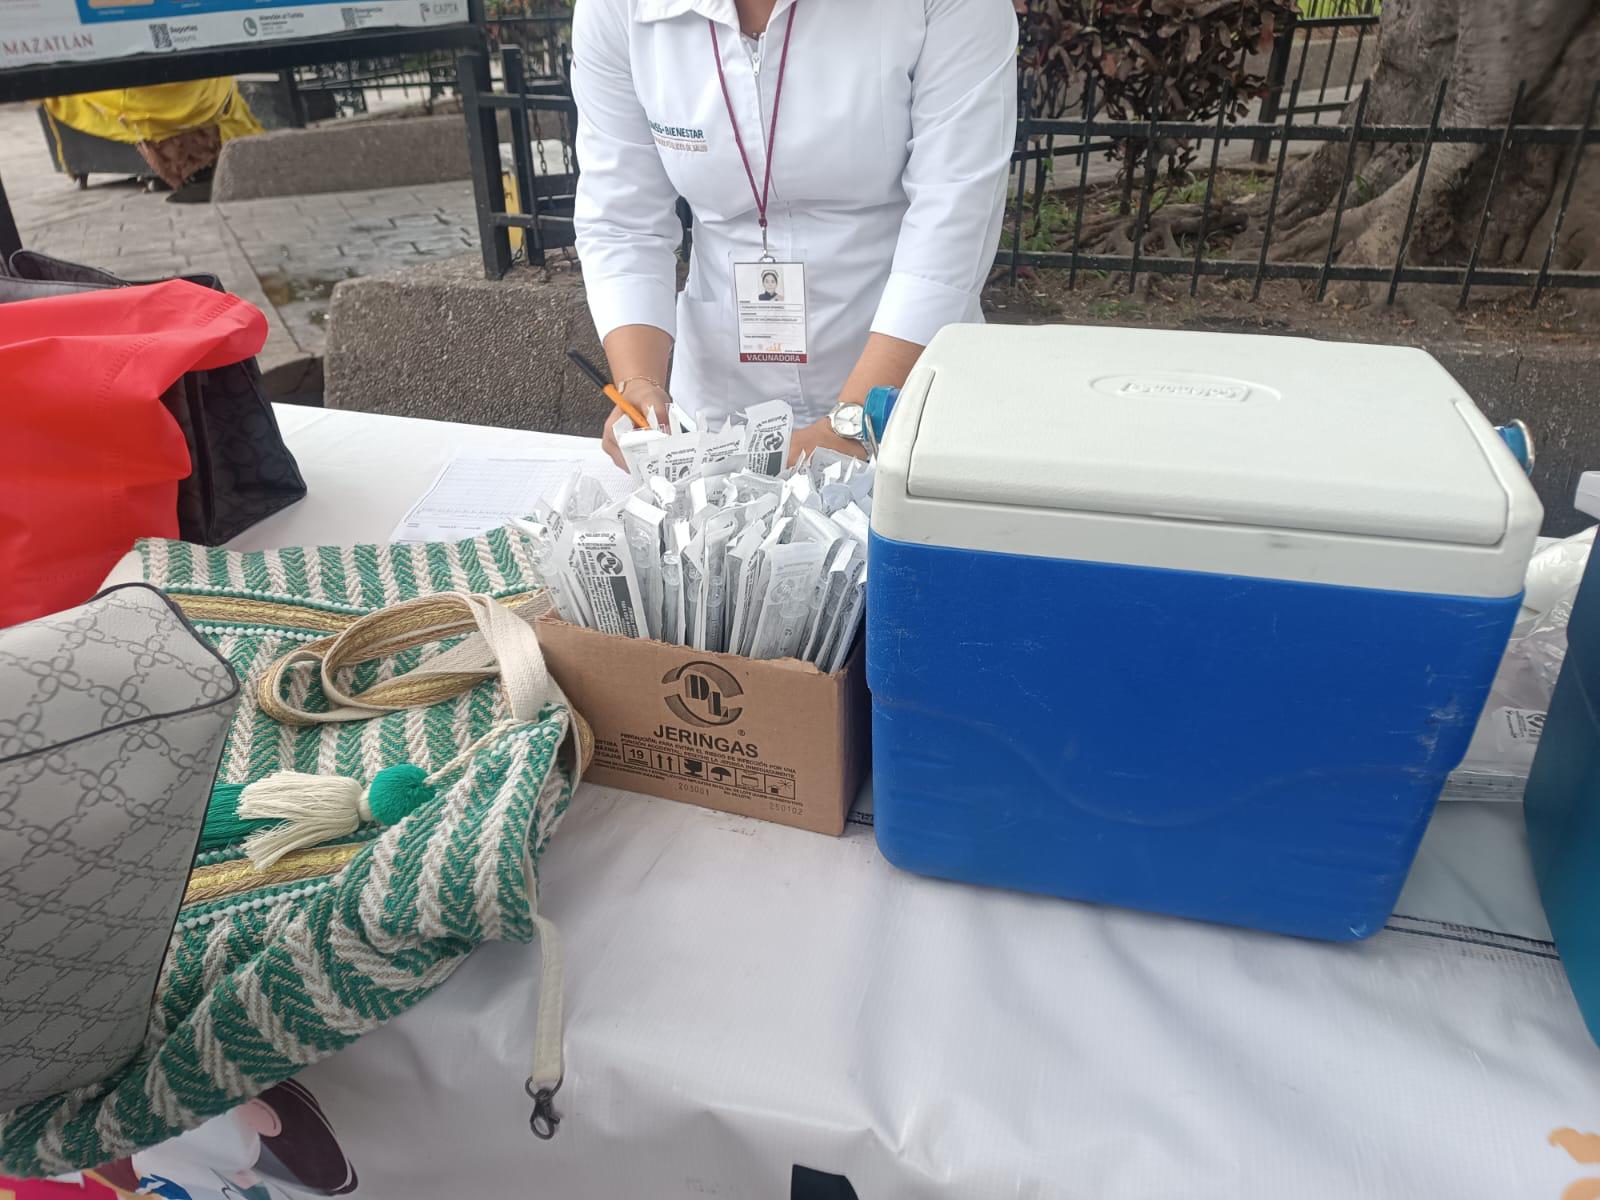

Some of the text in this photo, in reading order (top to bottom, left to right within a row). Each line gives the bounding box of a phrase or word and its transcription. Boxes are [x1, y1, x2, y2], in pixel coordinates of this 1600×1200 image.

[746, 353, 801, 362] VACUNADORA
[653, 725, 759, 758] JERINGAS
[629, 748, 645, 760] 19
